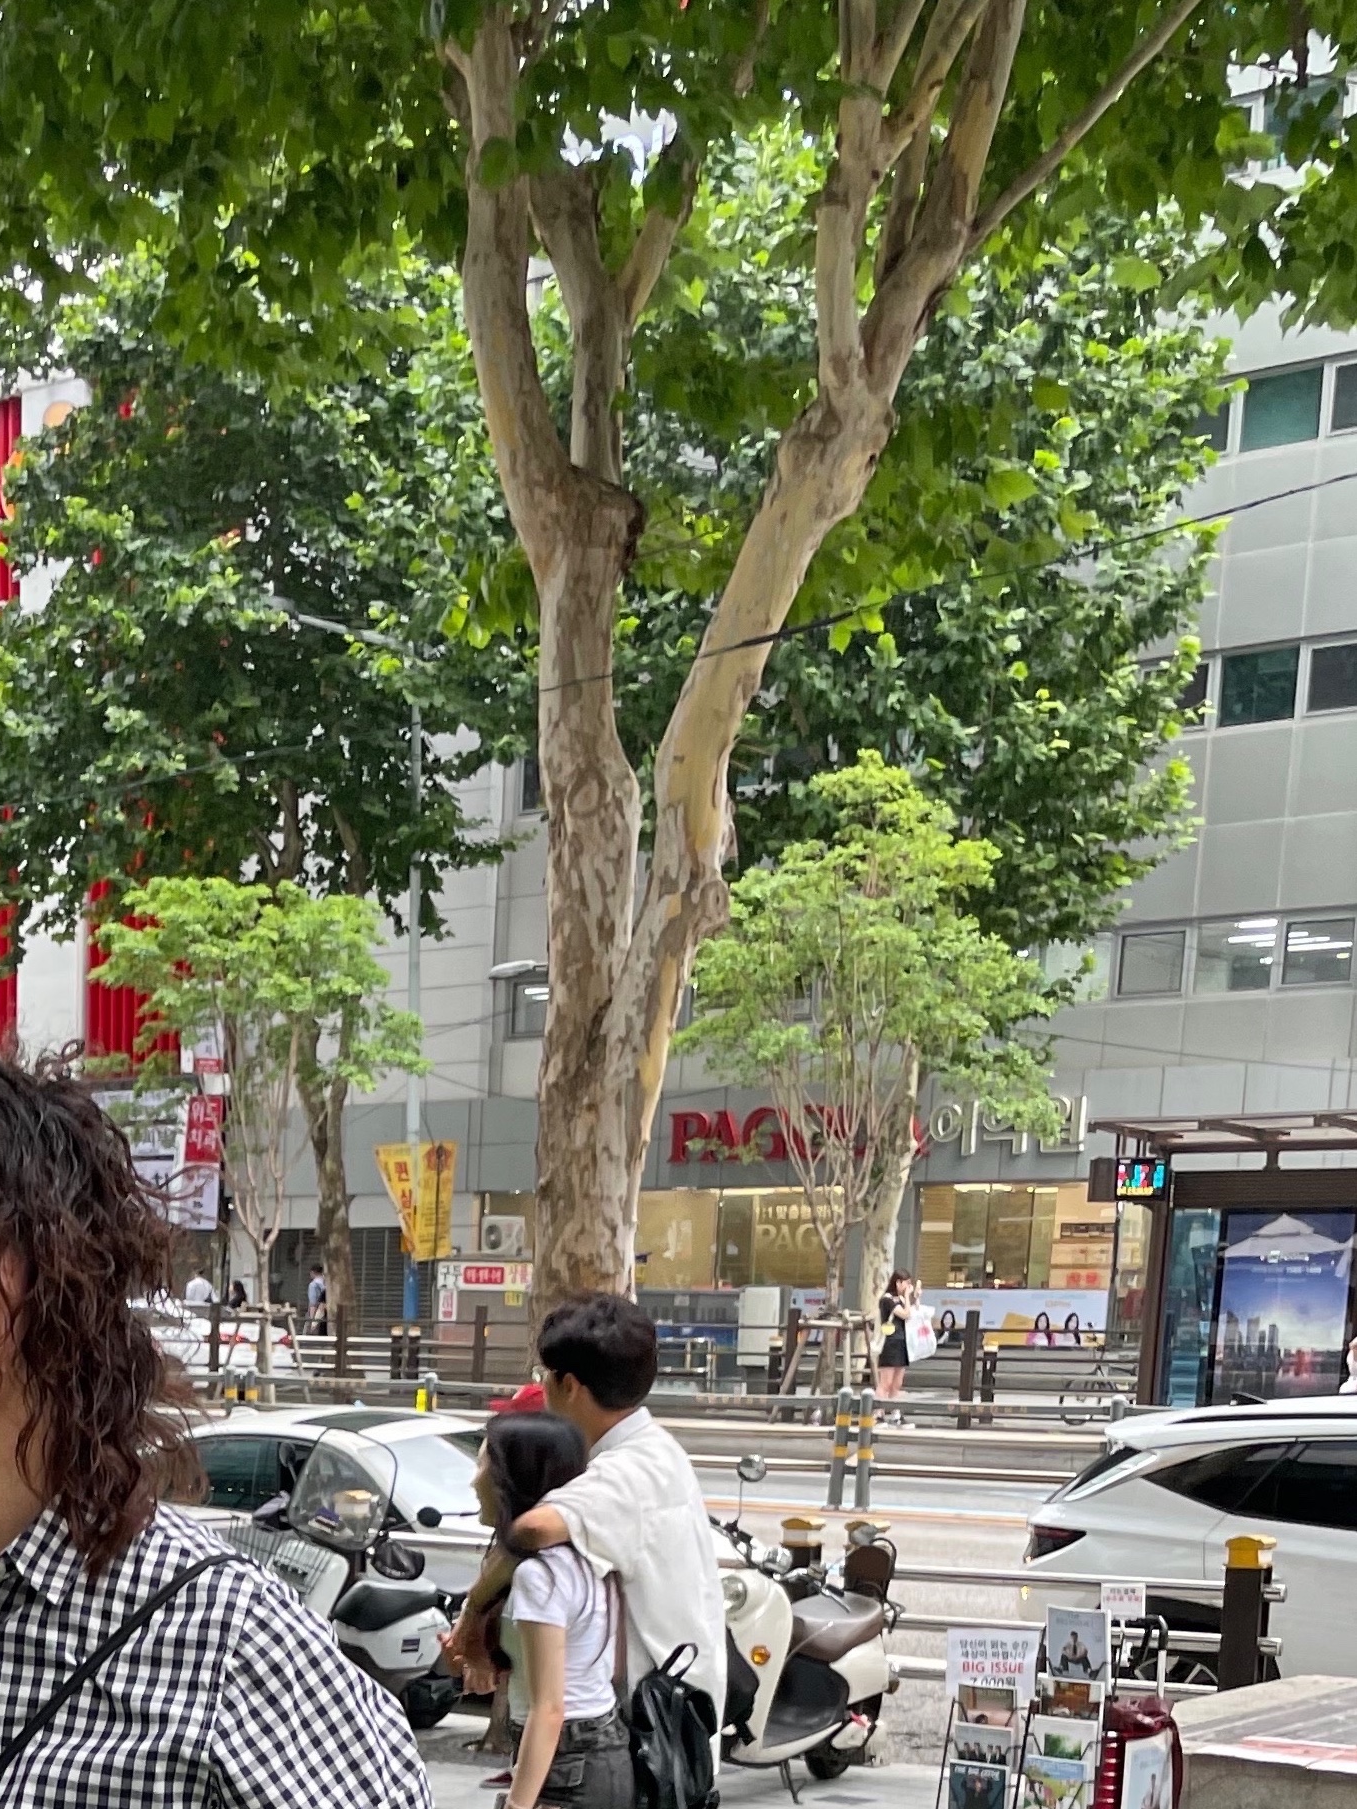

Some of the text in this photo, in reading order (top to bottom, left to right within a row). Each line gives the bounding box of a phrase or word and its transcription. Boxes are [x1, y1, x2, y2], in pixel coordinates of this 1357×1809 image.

[667, 1104, 931, 1164] PAGO
[963, 1661, 1025, 1674] BIG ISSUE
